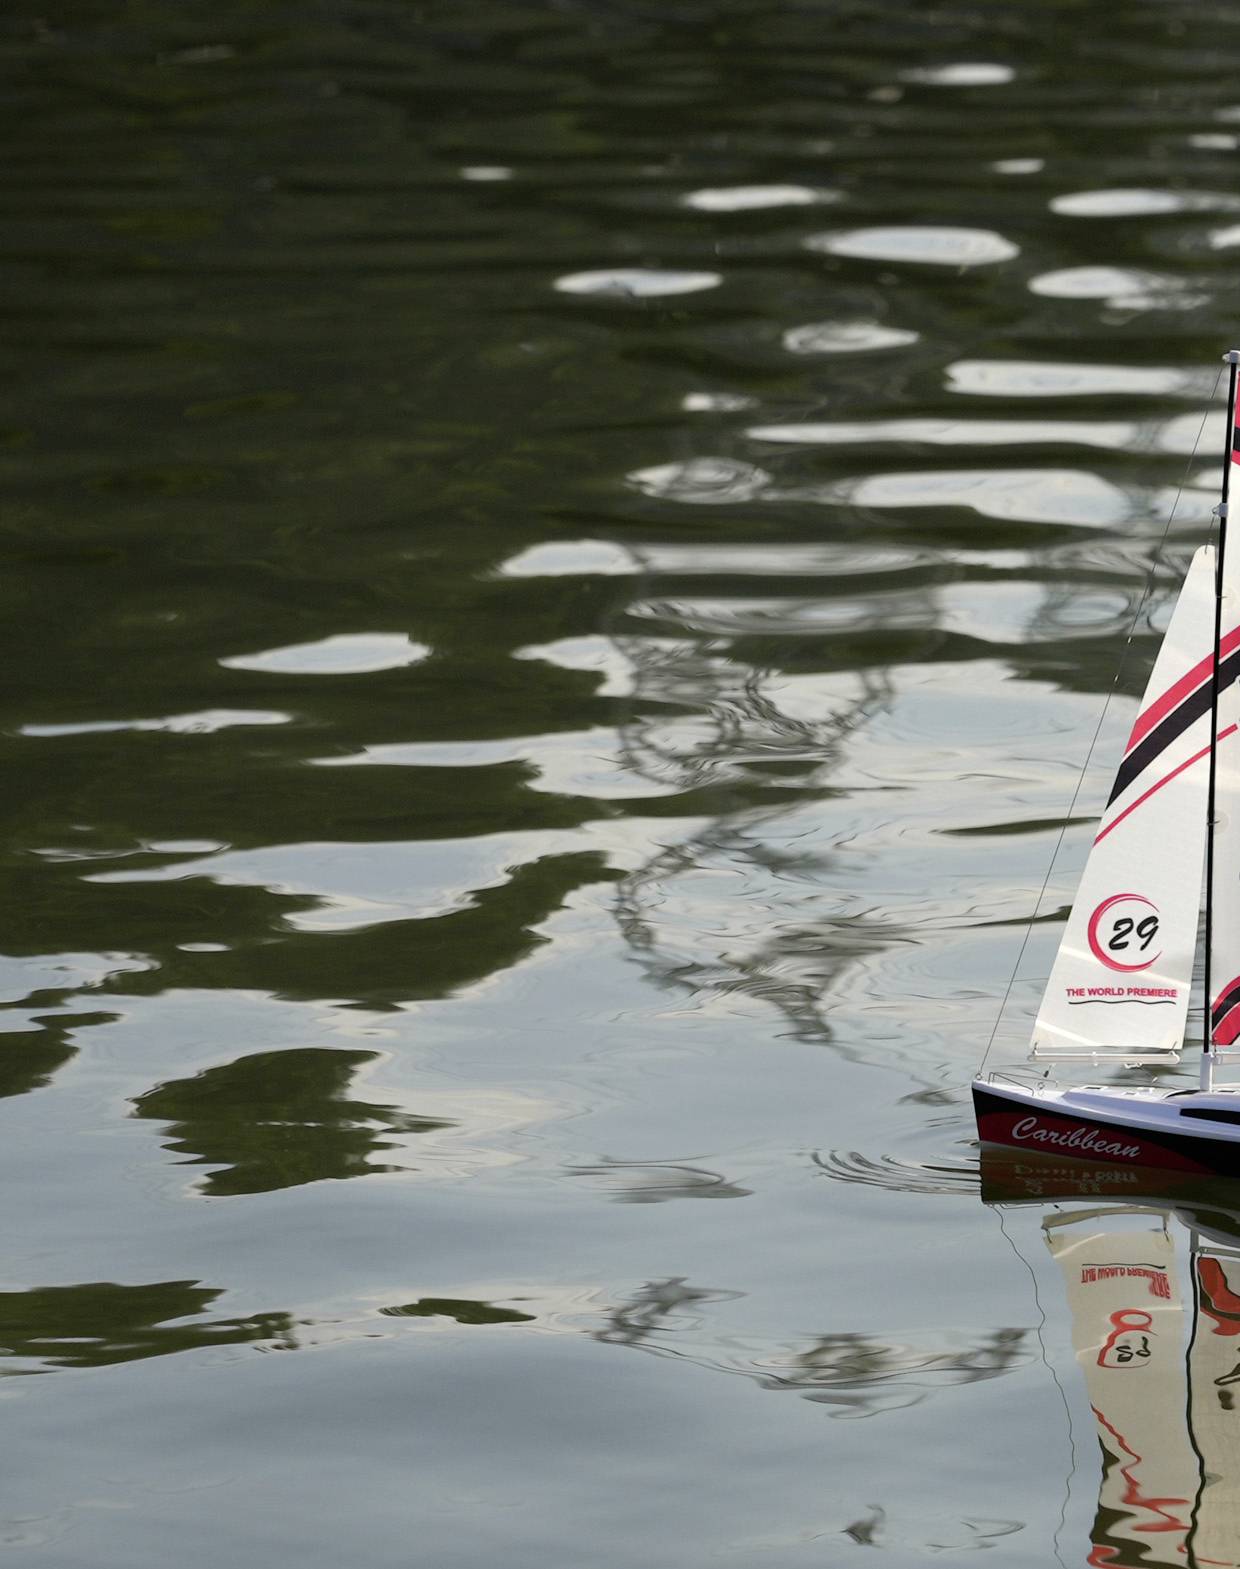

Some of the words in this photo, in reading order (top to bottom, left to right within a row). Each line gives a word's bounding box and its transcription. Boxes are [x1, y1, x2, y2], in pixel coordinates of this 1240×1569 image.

[1108, 915, 1160, 951] 29
[1066, 988, 1085, 997] THE
[1087, 987, 1125, 997] WORLD
[1127, 988, 1178, 998] PREMIERE
[1011, 1116, 1141, 1158] Caribbean
